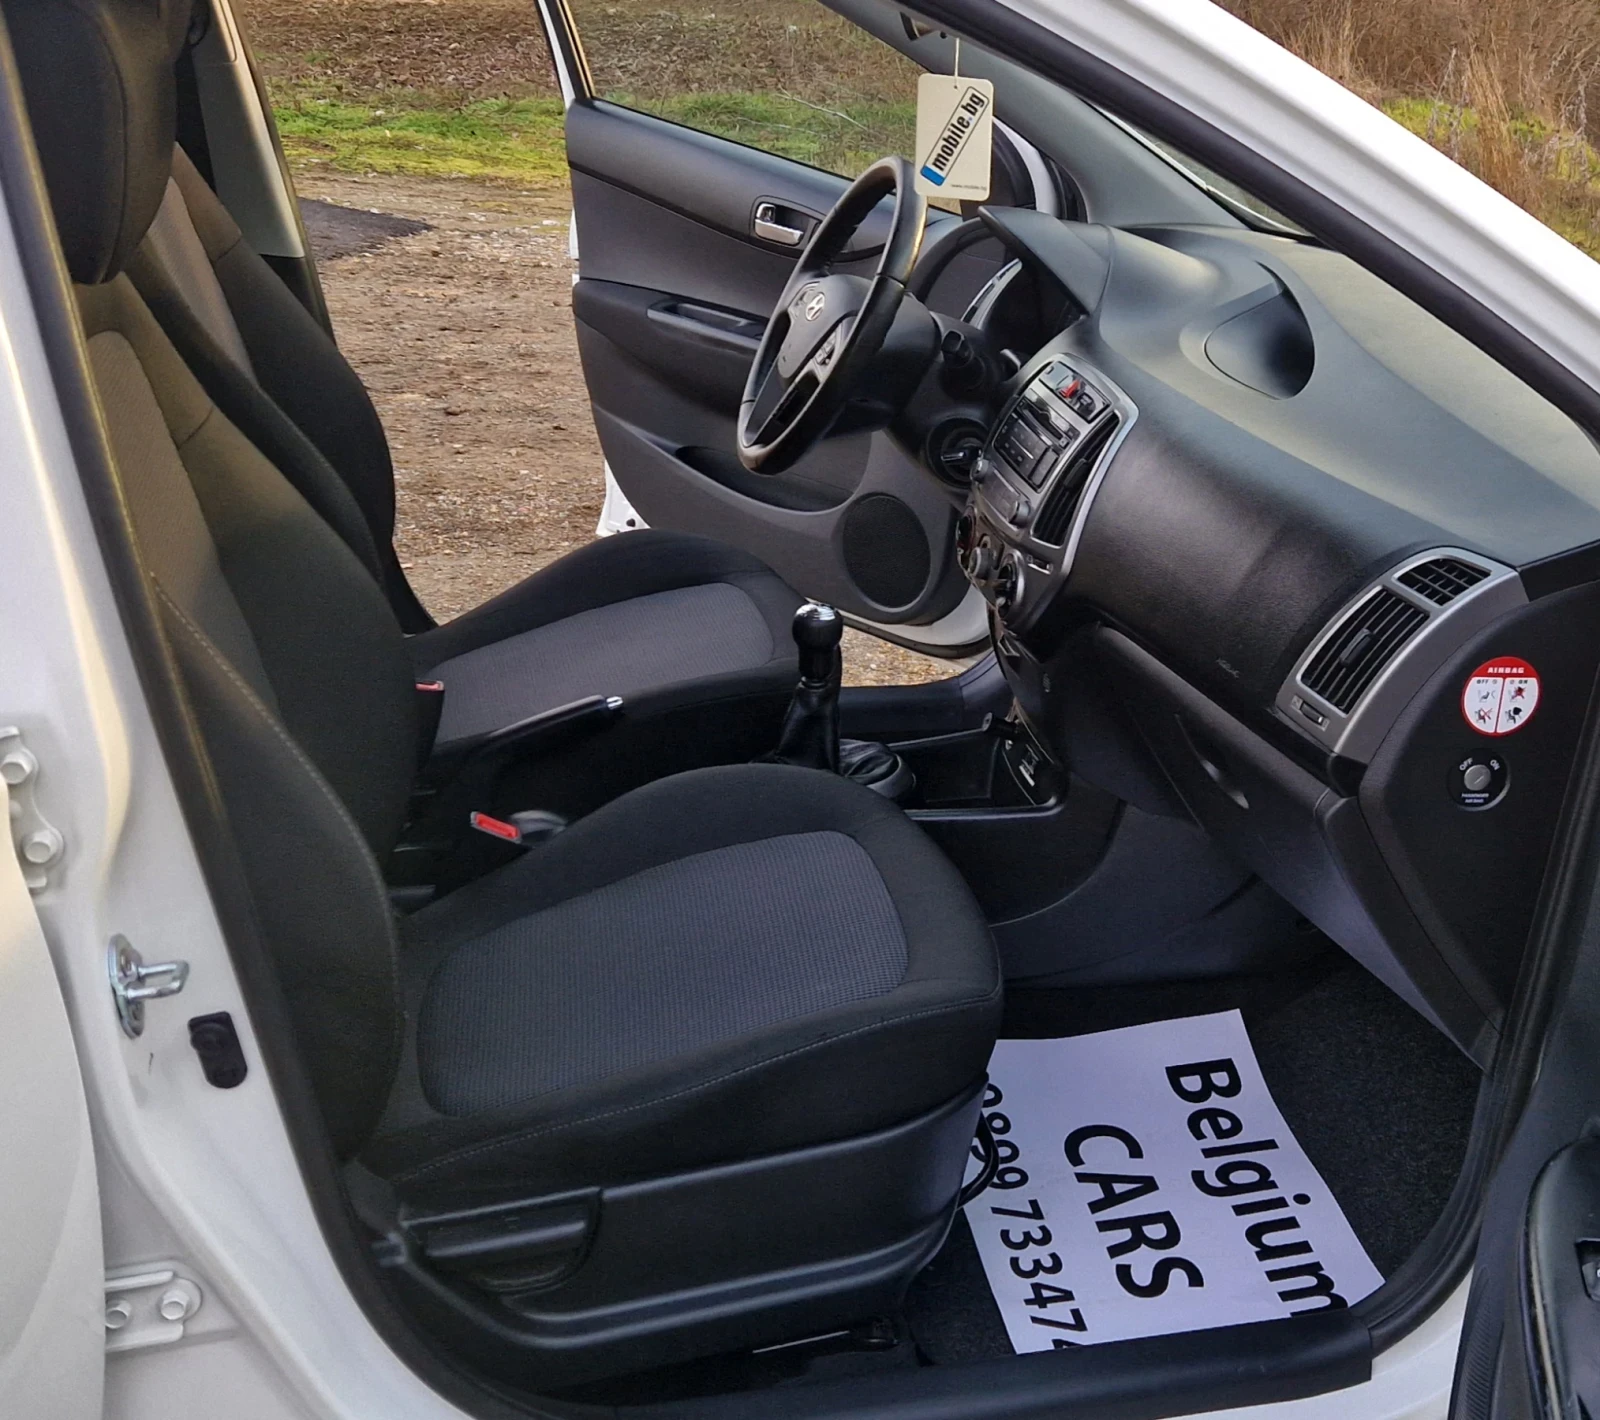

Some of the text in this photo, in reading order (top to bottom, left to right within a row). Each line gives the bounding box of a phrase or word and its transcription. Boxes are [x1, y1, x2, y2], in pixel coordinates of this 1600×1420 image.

[931, 92, 985, 172] mobile.bg
[1459, 757, 1473, 771] OFF
[1490, 759, 1500, 771] ON
[1063, 1124, 1205, 1299] CARS
[1164, 1057, 1349, 1318] Belgium
[990, 1199, 1089, 1350] 73347
